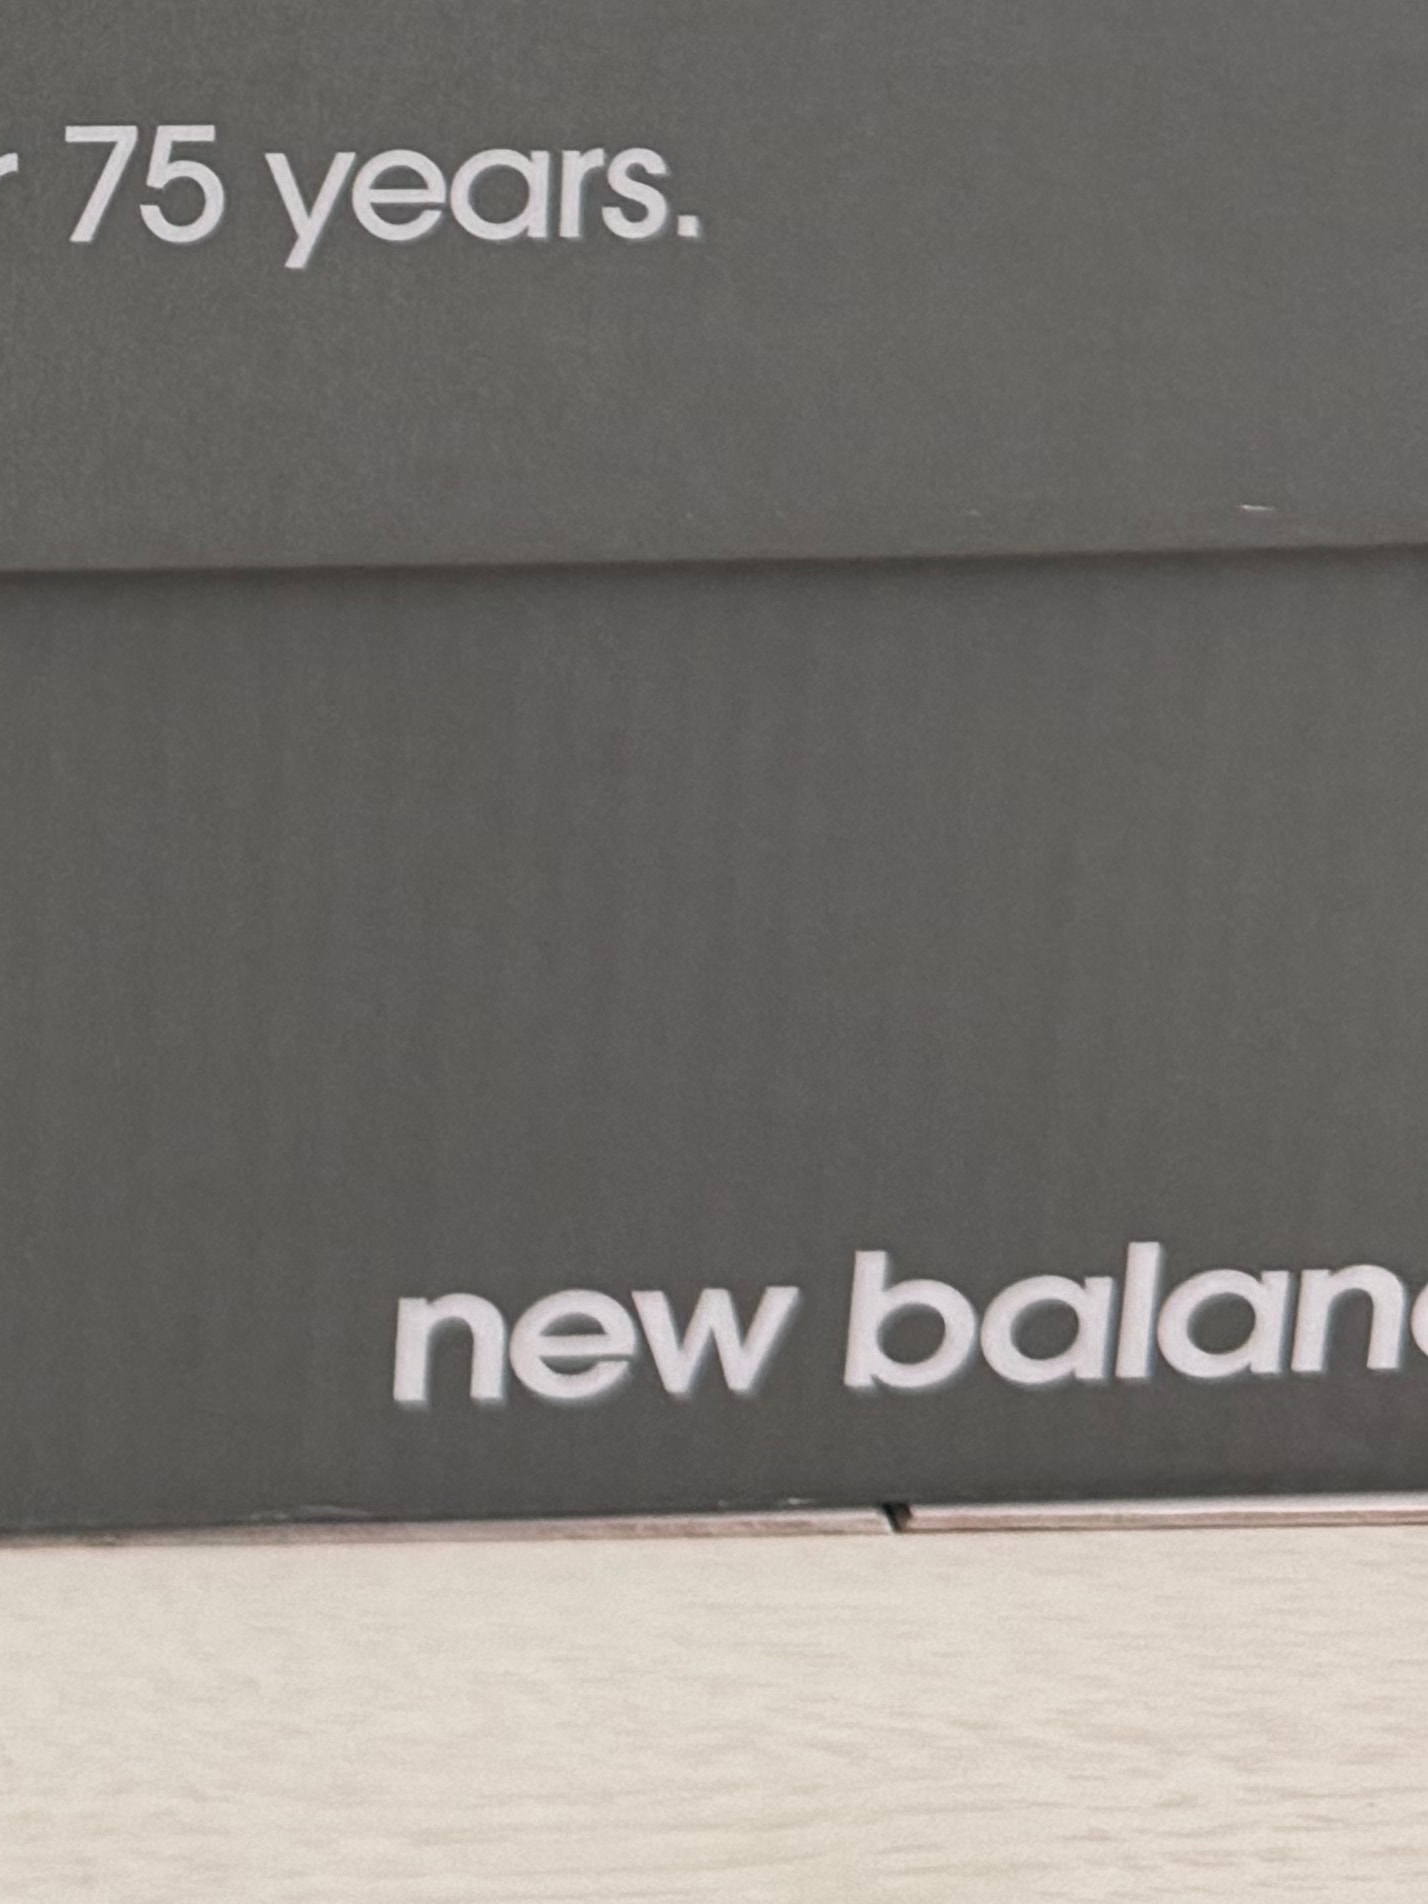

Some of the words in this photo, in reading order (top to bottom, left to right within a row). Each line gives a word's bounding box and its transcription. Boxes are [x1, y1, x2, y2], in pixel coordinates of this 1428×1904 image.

[63, 123, 226, 245] 75
[263, 145, 701, 271] years.
[392, 1284, 801, 1407] new
[842, 1240, 1428, 1392] balan
